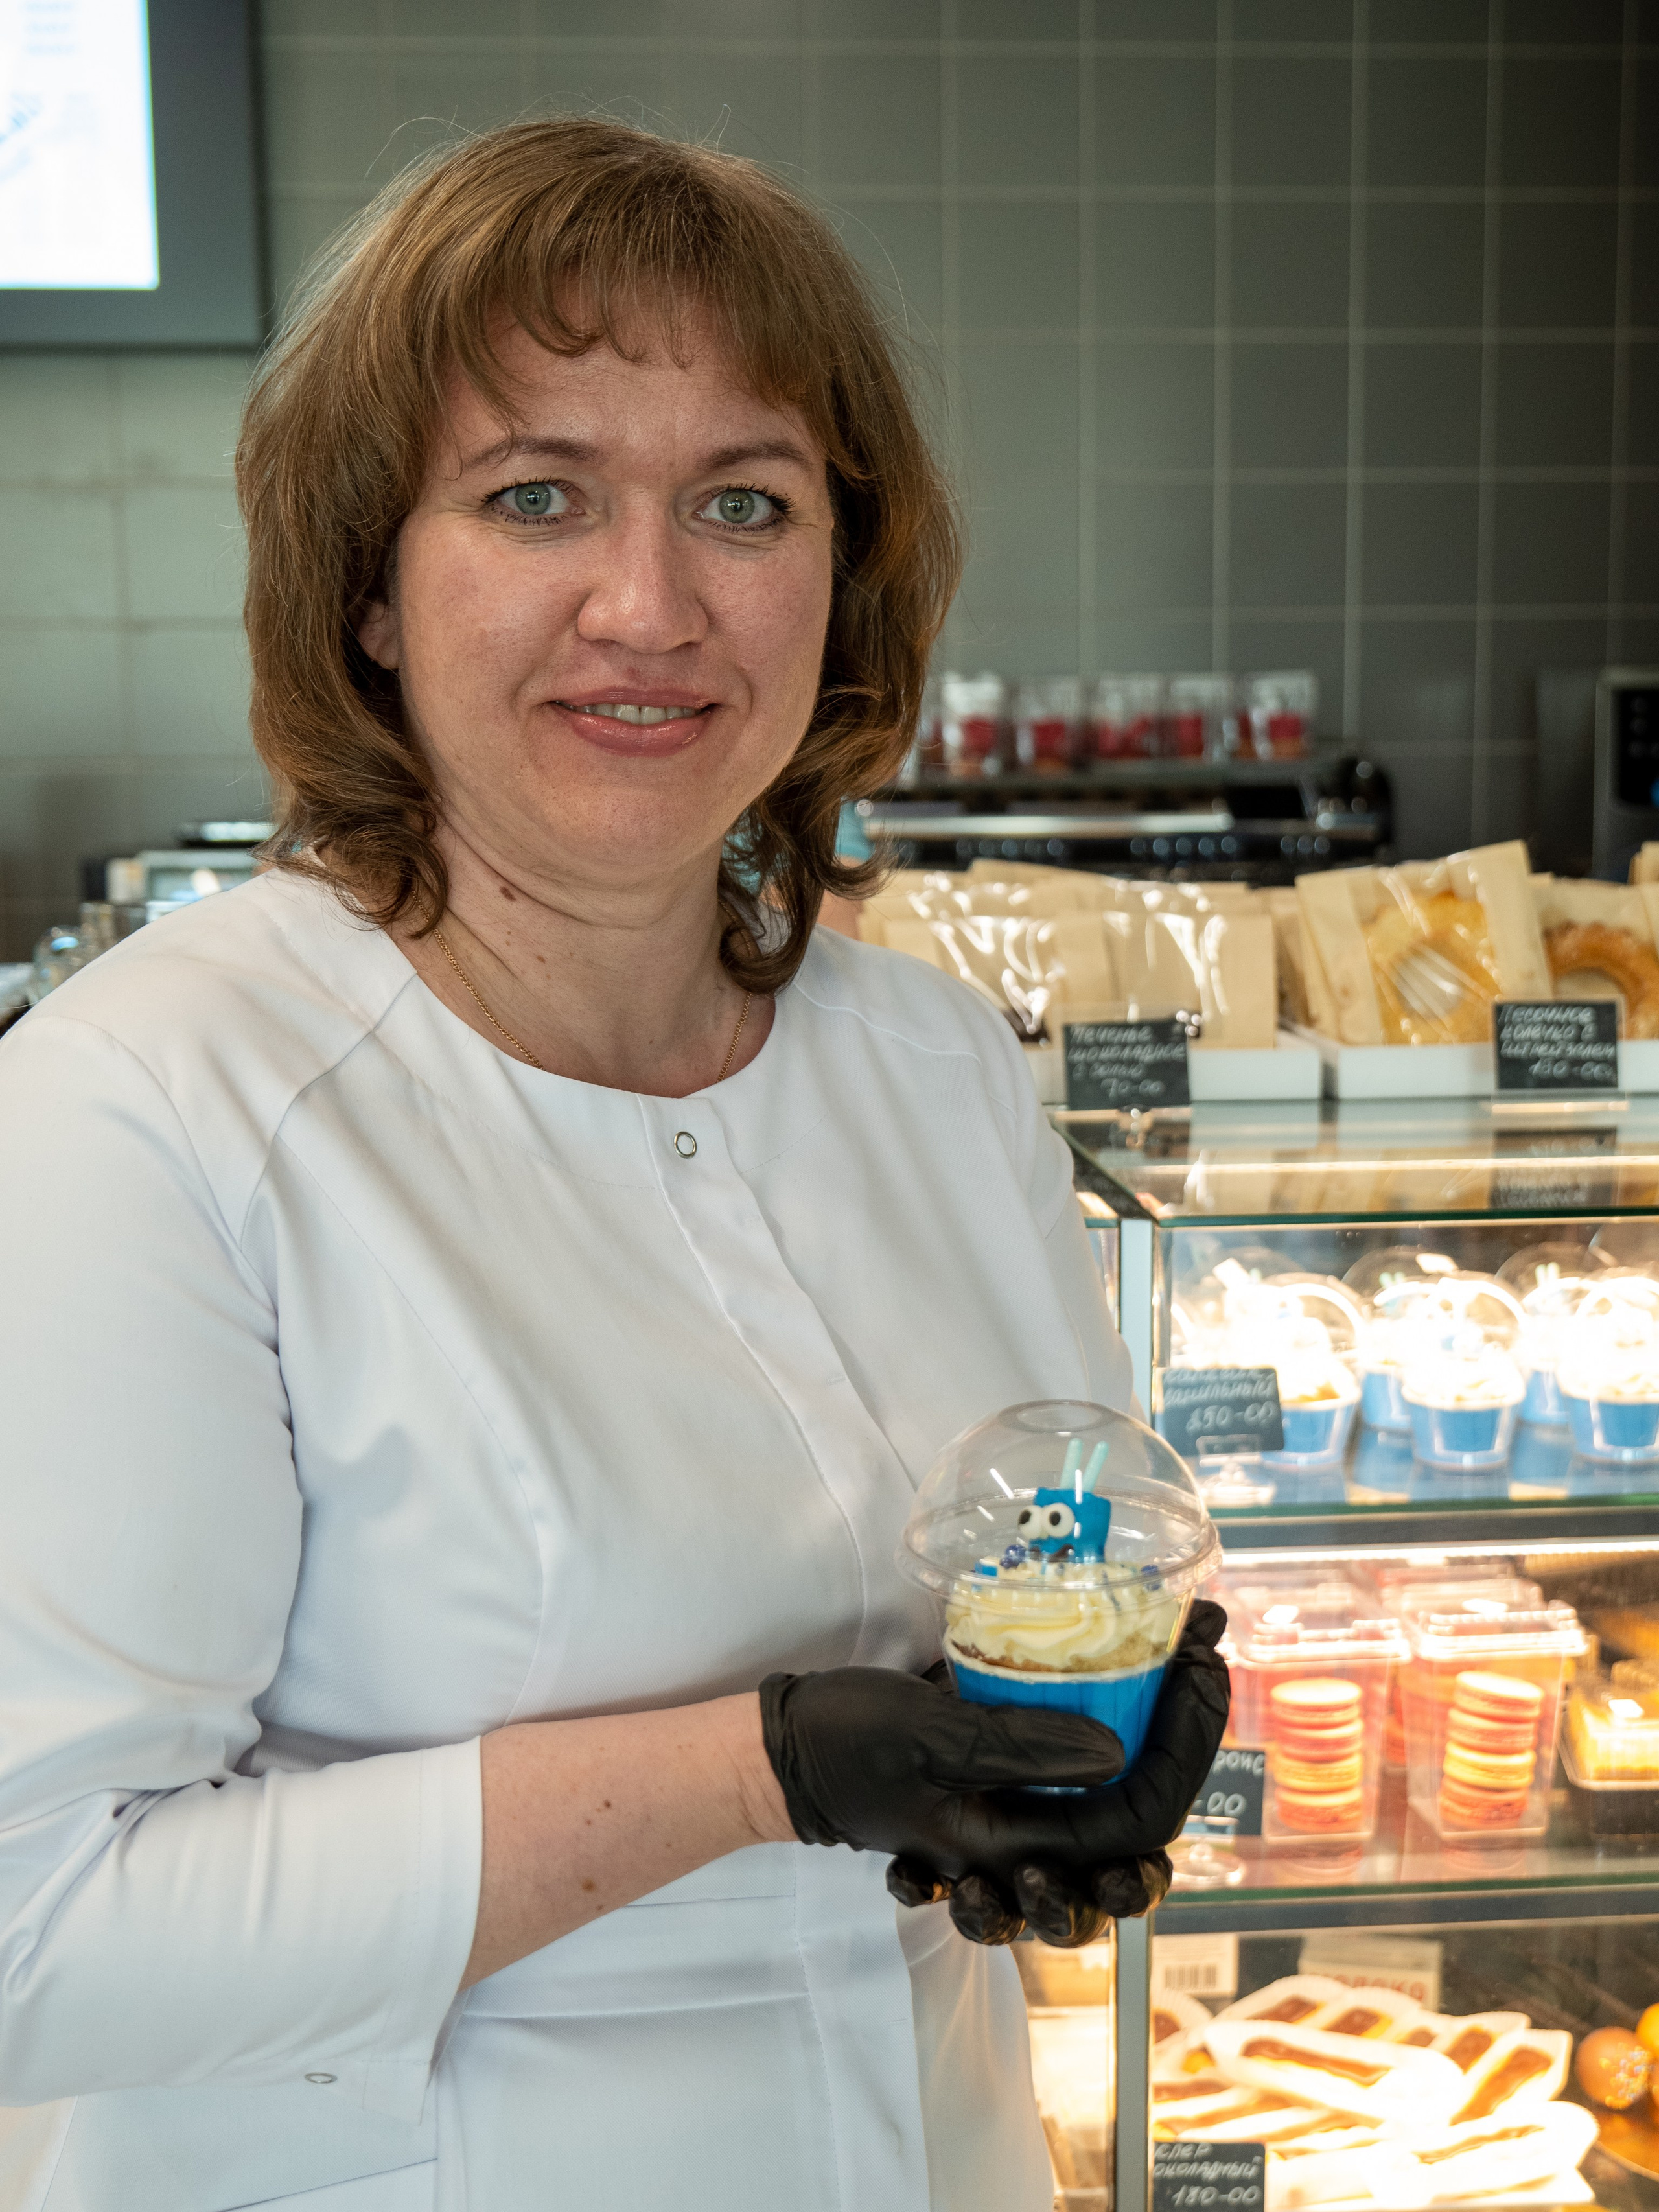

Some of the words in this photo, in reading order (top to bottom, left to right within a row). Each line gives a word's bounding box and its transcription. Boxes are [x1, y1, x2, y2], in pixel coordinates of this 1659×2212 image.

[1100, 1078, 1165, 1099] 70-00
[1194, 1791, 1246, 1817] -00
[1172, 2185, 1262, 2207] 180-00
